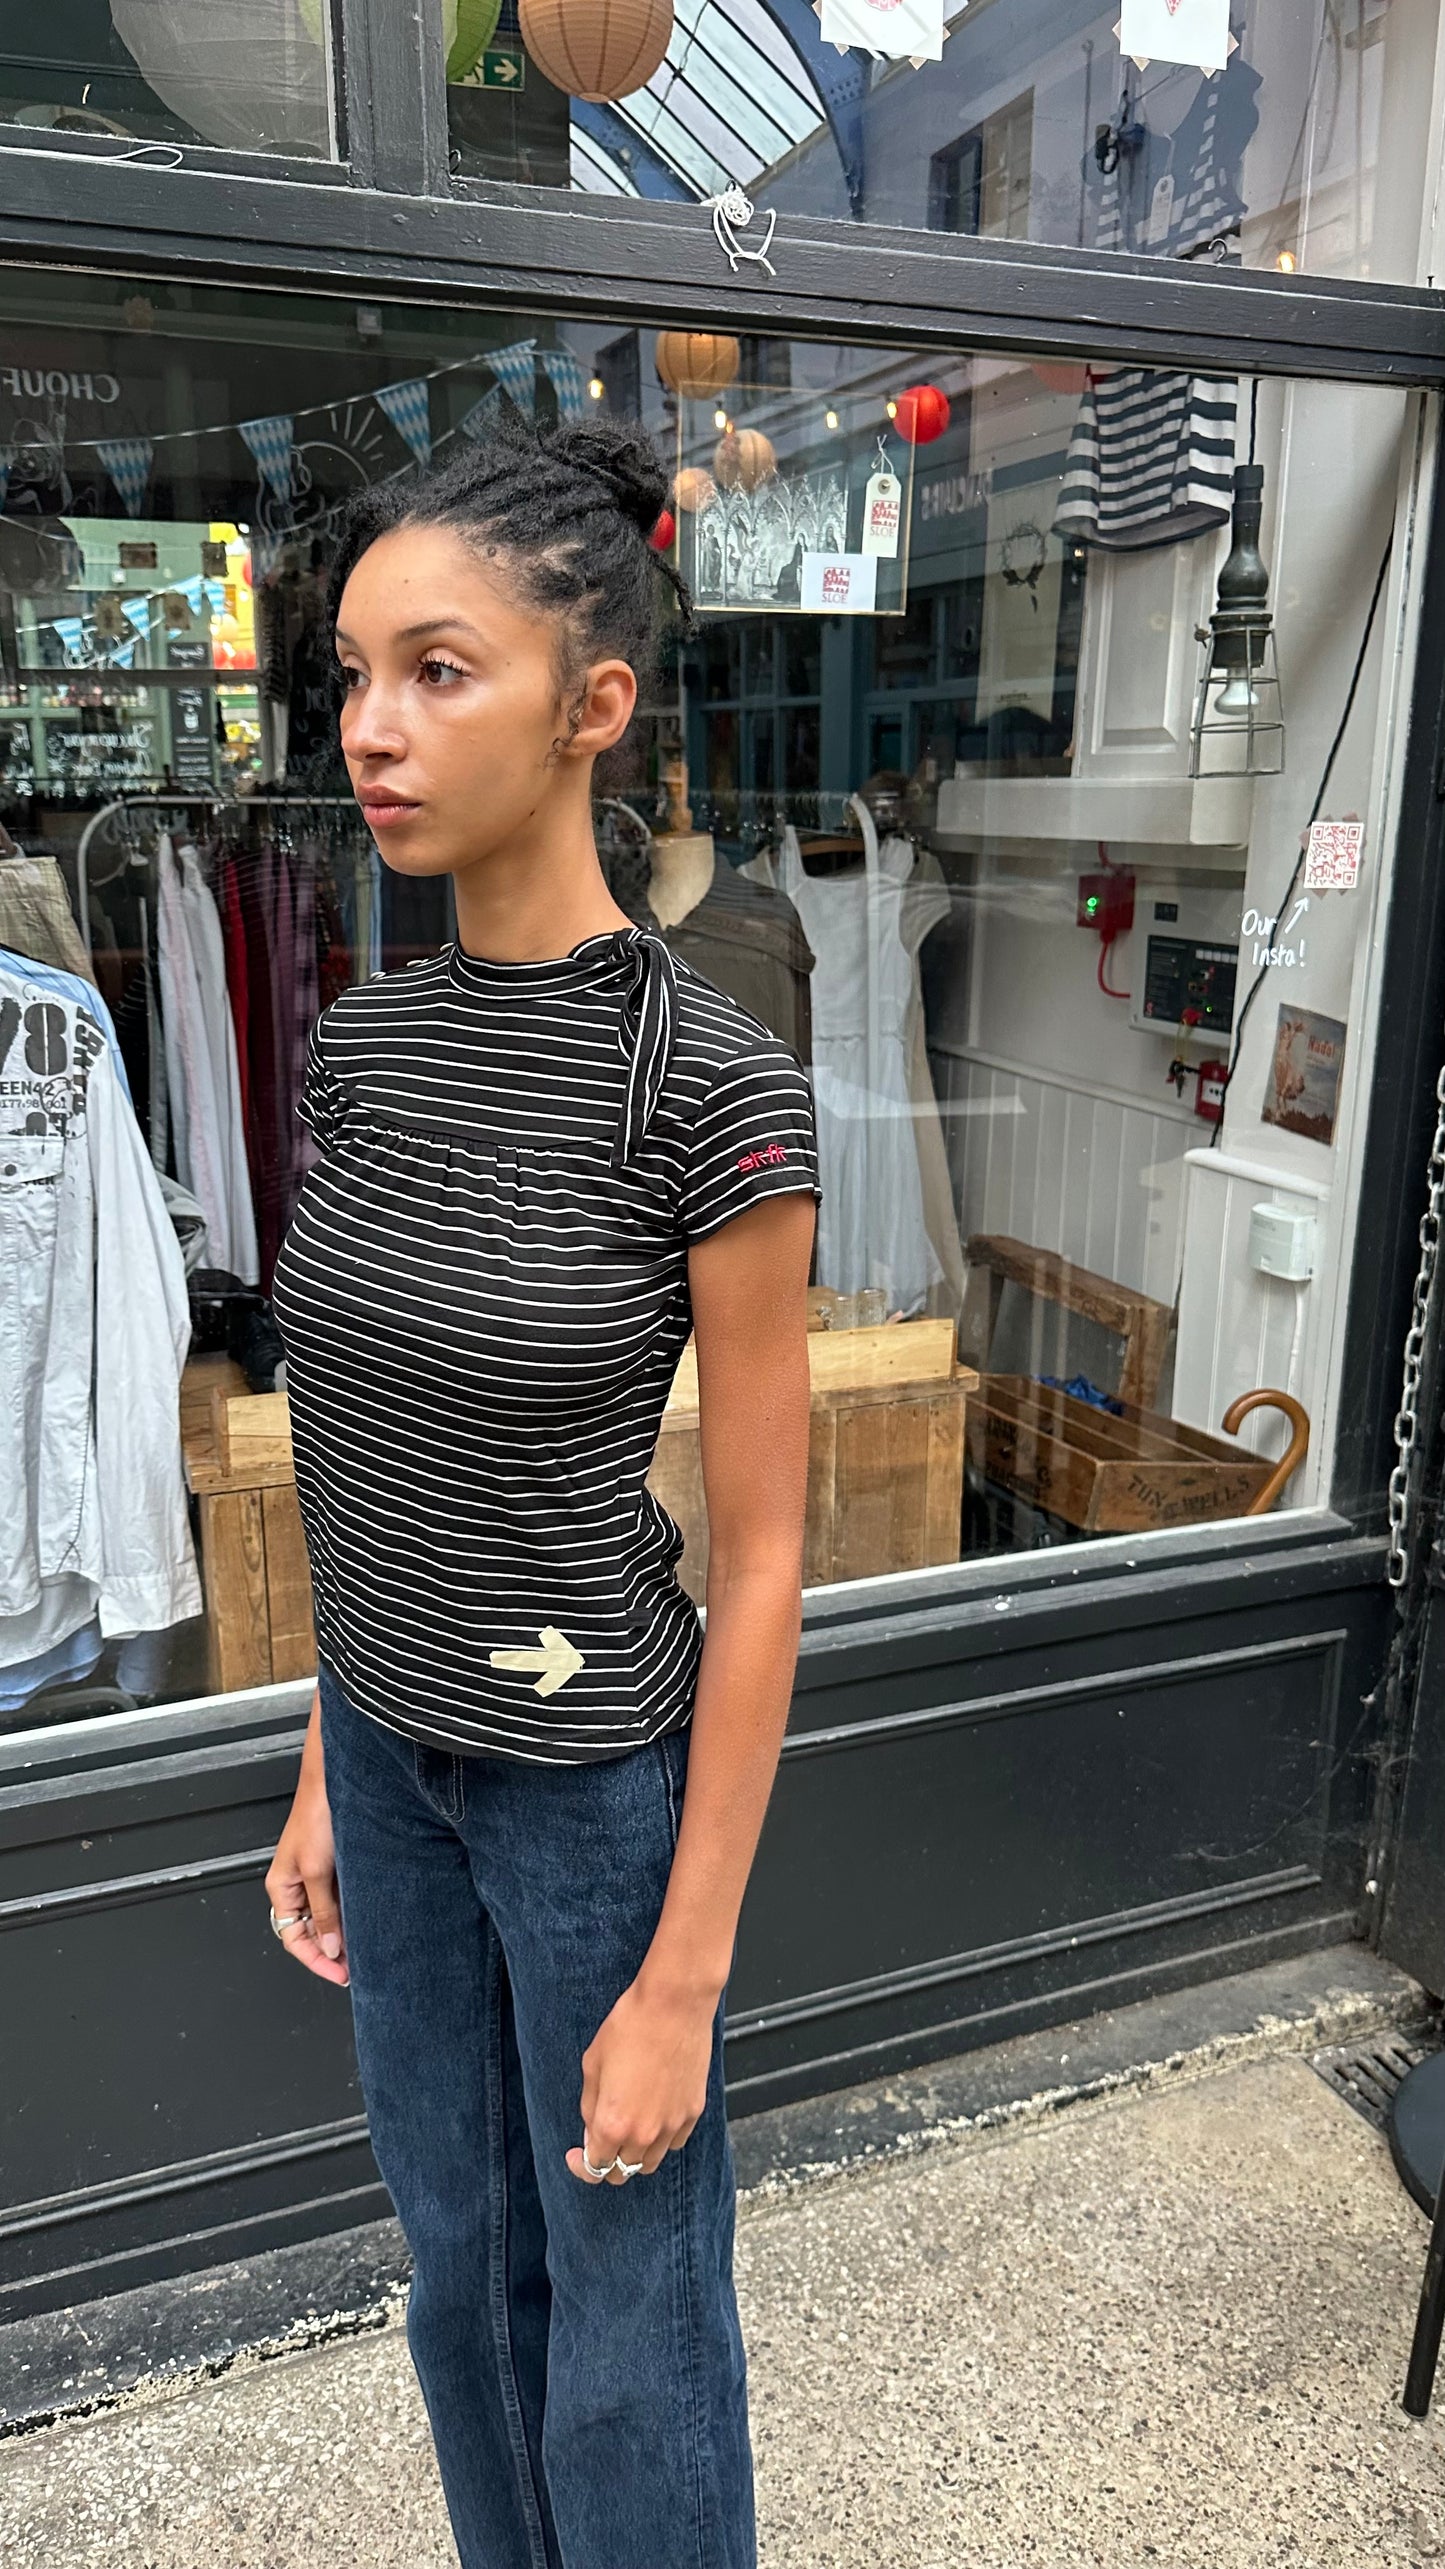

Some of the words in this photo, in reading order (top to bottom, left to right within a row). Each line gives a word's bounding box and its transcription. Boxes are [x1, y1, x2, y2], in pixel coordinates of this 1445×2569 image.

[869, 526, 895, 538] SLOE
[821, 592, 848, 605] SLOE
[1241, 908, 1277, 936] Our
[1252, 939, 1306, 968] Insta!
